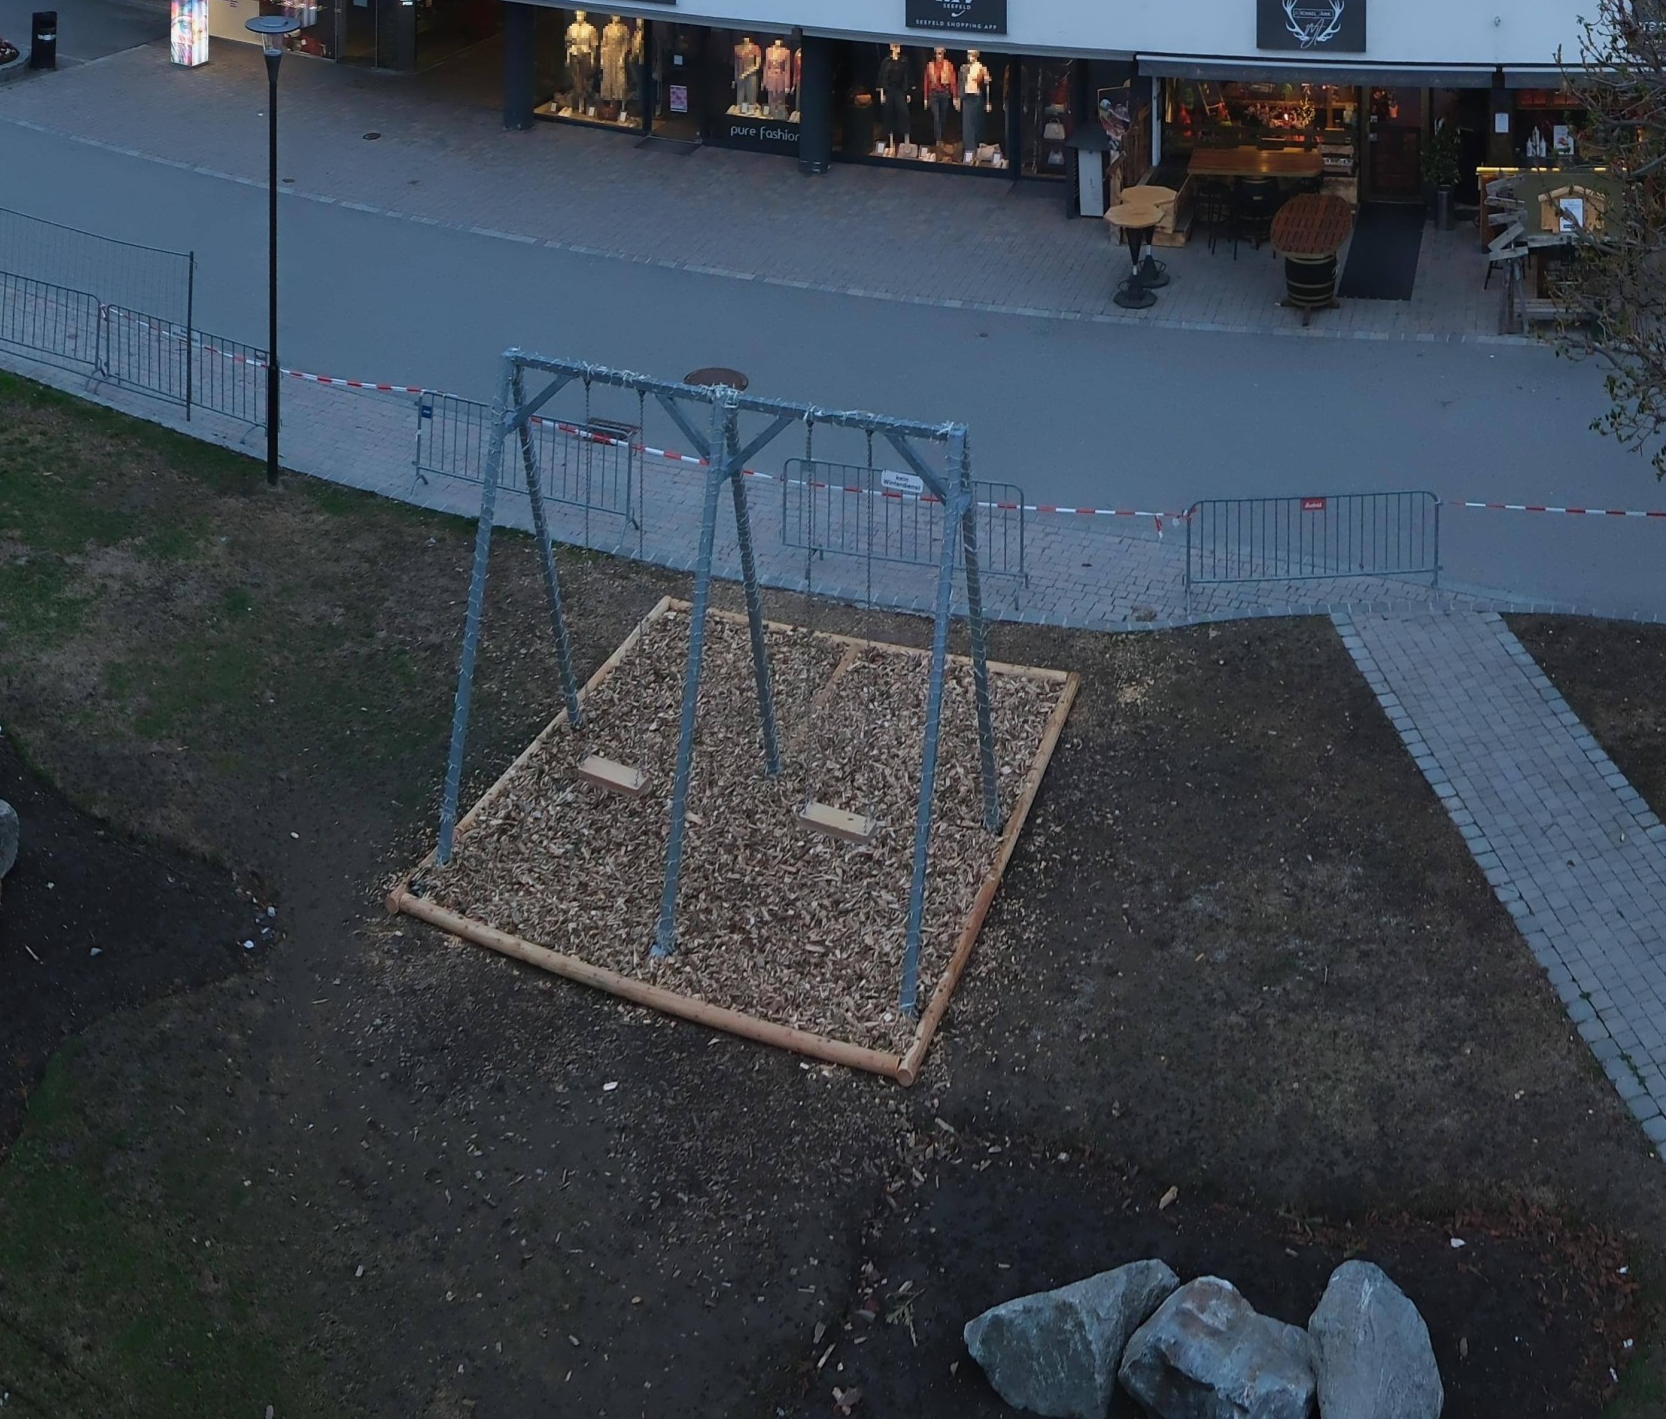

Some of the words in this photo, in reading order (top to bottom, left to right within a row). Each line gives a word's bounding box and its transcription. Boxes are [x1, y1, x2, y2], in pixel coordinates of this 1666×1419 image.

[916, 19, 944, 27] SEEFELD
[946, 21, 982, 29] SHOPPING
[730, 124, 756, 137] pure
